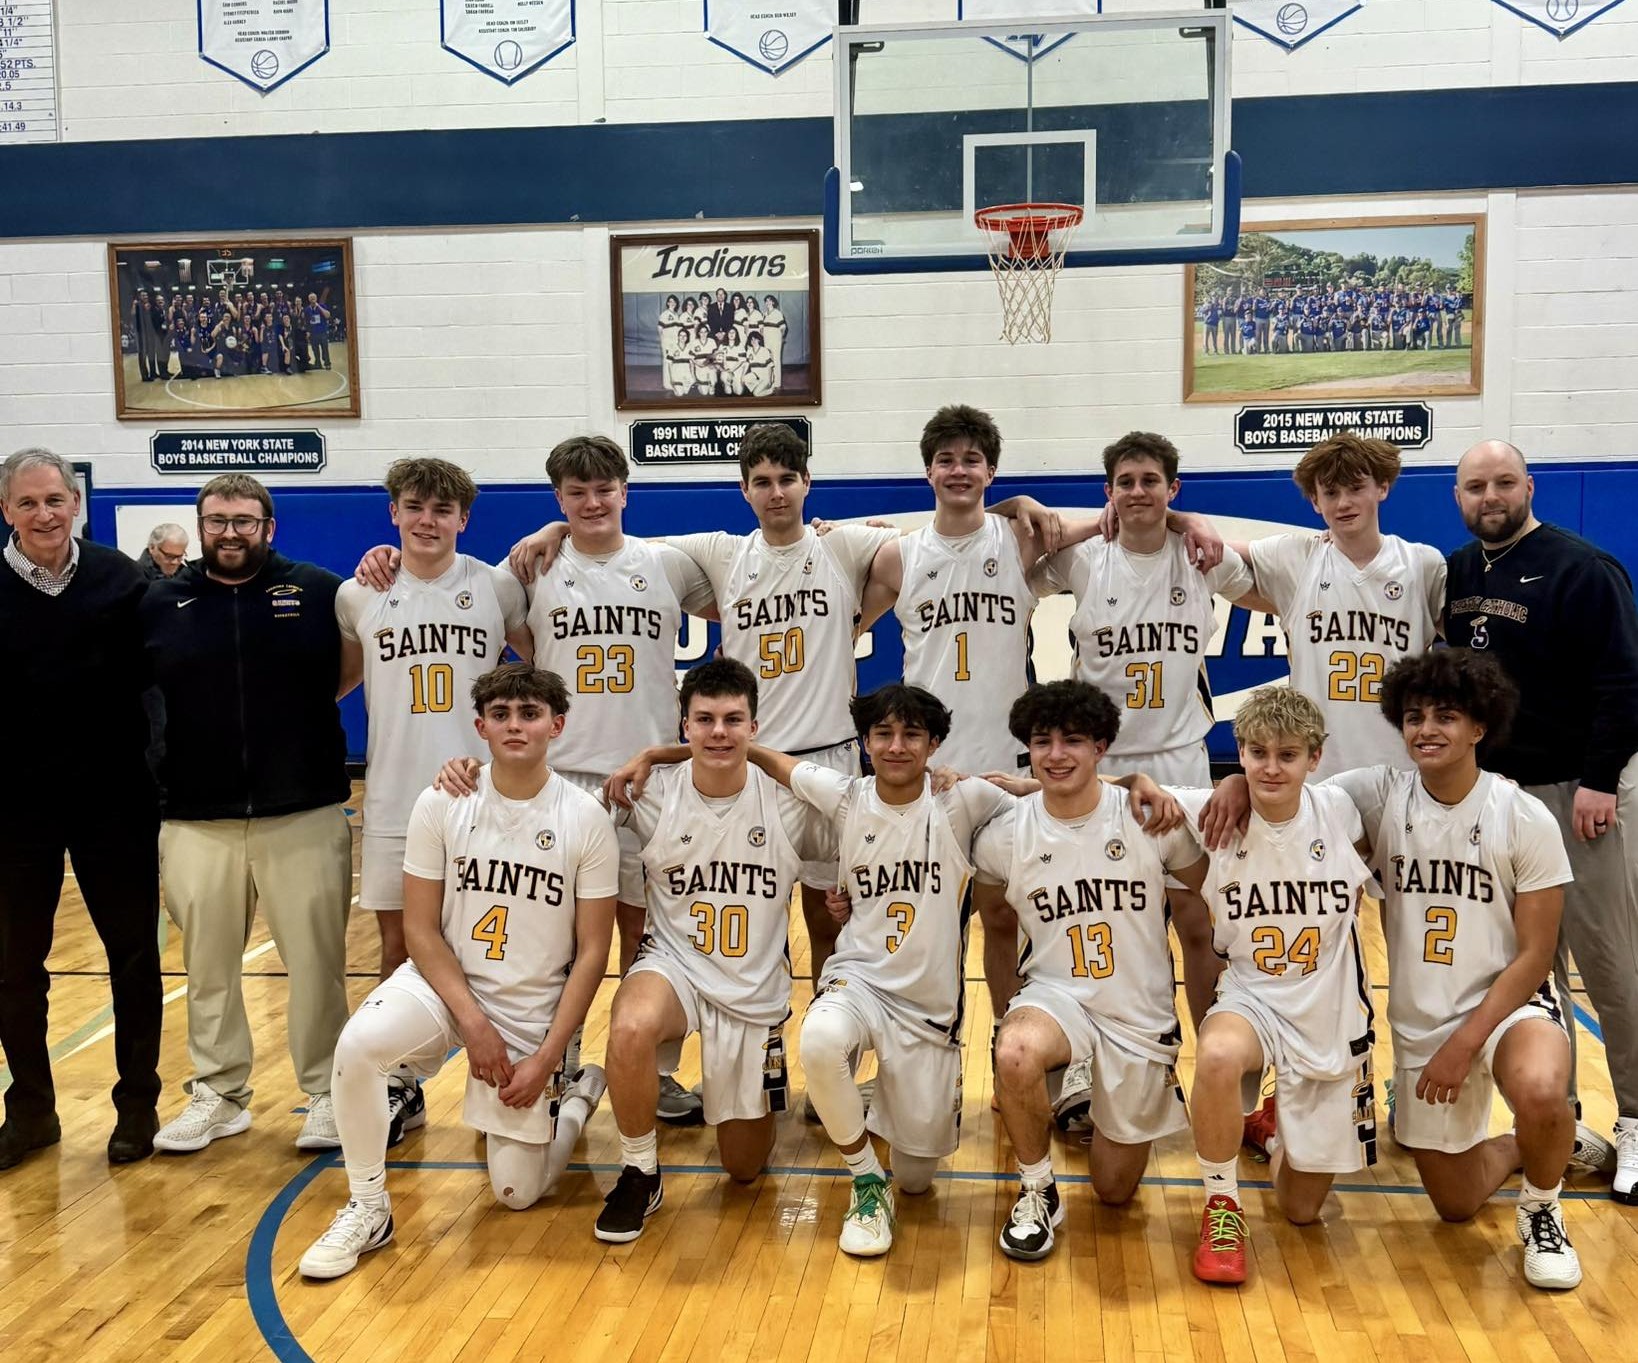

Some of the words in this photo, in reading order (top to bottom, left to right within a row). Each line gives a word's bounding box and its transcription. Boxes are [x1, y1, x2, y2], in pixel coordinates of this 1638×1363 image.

[652, 245, 786, 278] Indians
[652, 426, 677, 440] 1991
[681, 425, 709, 439] NEW
[714, 424, 747, 438] YORK
[1244, 429, 1277, 445] BOYS
[1263, 413, 1292, 427] 2015
[1295, 412, 1324, 427] NEW
[1326, 411, 1361, 426] YORK
[1364, 410, 1404, 425] STATE
[158, 453, 186, 465] BOYS
[189, 453, 256, 465] BASKETBALL
[257, 452, 319, 464] CHAMPIONS
[181, 439, 203, 451] 2014
[206, 439, 229, 450] NEW
[231, 438, 260, 450] YORK
[262, 438, 294, 450] STATE
[645, 442, 722, 457] BASKETBALL
[552, 604, 662, 640] SAINTS
[737, 588, 829, 631] SAINTS
[920, 591, 1016, 632] SAINTS
[379, 622, 488, 662] SAINTS
[759, 626, 805, 679] 50
[1097, 621, 1199, 658] SAINTS
[1310, 610, 1411, 653] SAINTS
[576, 644, 634, 694] 23
[954, 631, 971, 681] 1
[1327, 650, 1386, 703] 22
[409, 663, 453, 714] 10
[1124, 660, 1165, 709] 31
[668, 860, 777, 899] SAINTS
[1033, 878, 1147, 923] SAINTS
[1225, 879, 1350, 921] SAINTS
[1394, 858, 1494, 904] SAINTS
[470, 904, 510, 961] 4
[686, 900, 749, 958] 30
[885, 901, 916, 954] 3
[1423, 905, 1458, 966] 2
[1066, 921, 1115, 980] 13
[1251, 926, 1321, 976] 24
